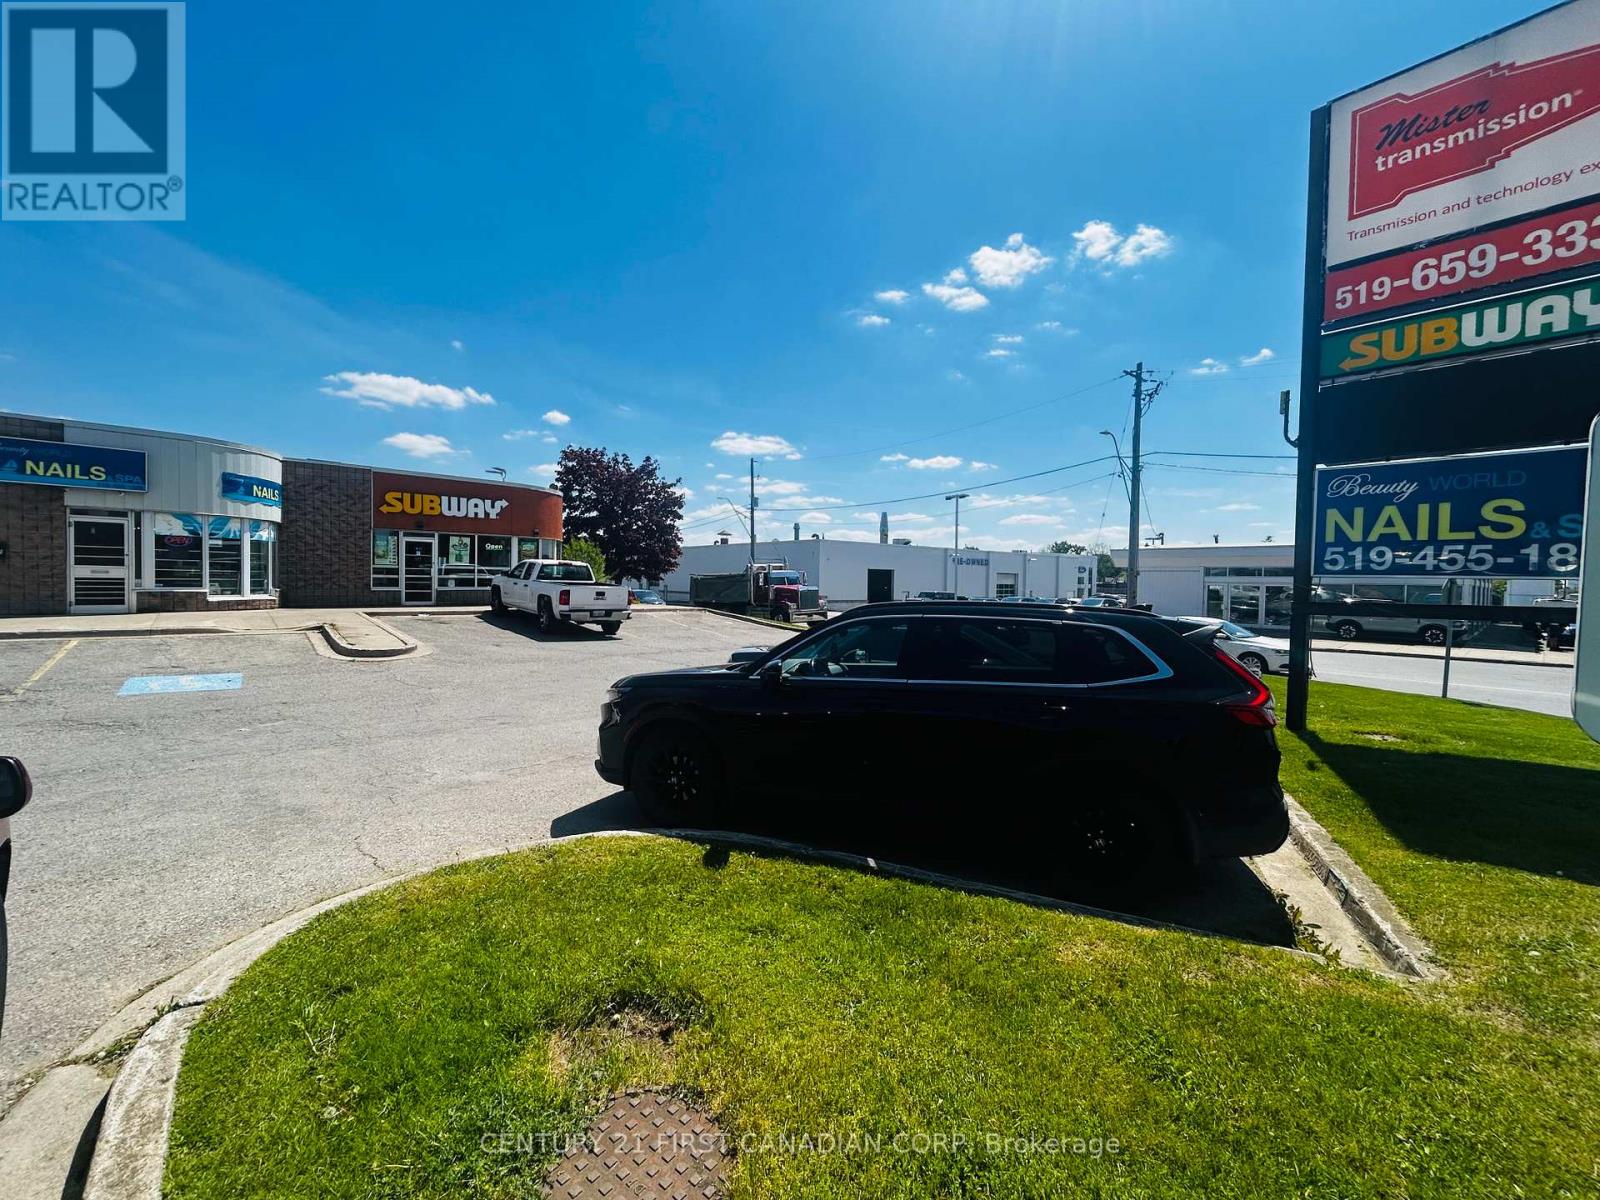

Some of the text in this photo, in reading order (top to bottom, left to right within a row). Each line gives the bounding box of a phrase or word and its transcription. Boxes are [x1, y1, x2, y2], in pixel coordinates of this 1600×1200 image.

[1375, 99, 1491, 150] Mister
[1375, 92, 1574, 172] transmission
[1347, 208, 1437, 241] Transmission
[1442, 198, 1471, 216] and
[1476, 168, 1574, 206] technology
[1338, 288, 1600, 371] SUBWAY
[25, 459, 107, 481] NAILS
[252, 484, 280, 501] NAILS
[1327, 470, 1527, 503] Beauty WORLD
[379, 491, 509, 519] SUBWAY
[1325, 498, 1527, 543] NAILS
[1530, 521, 1550, 539] &
[165, 535, 189, 545] OPEN
[485, 542, 503, 551] Open
[1323, 542, 1578, 572] 519-455-18
